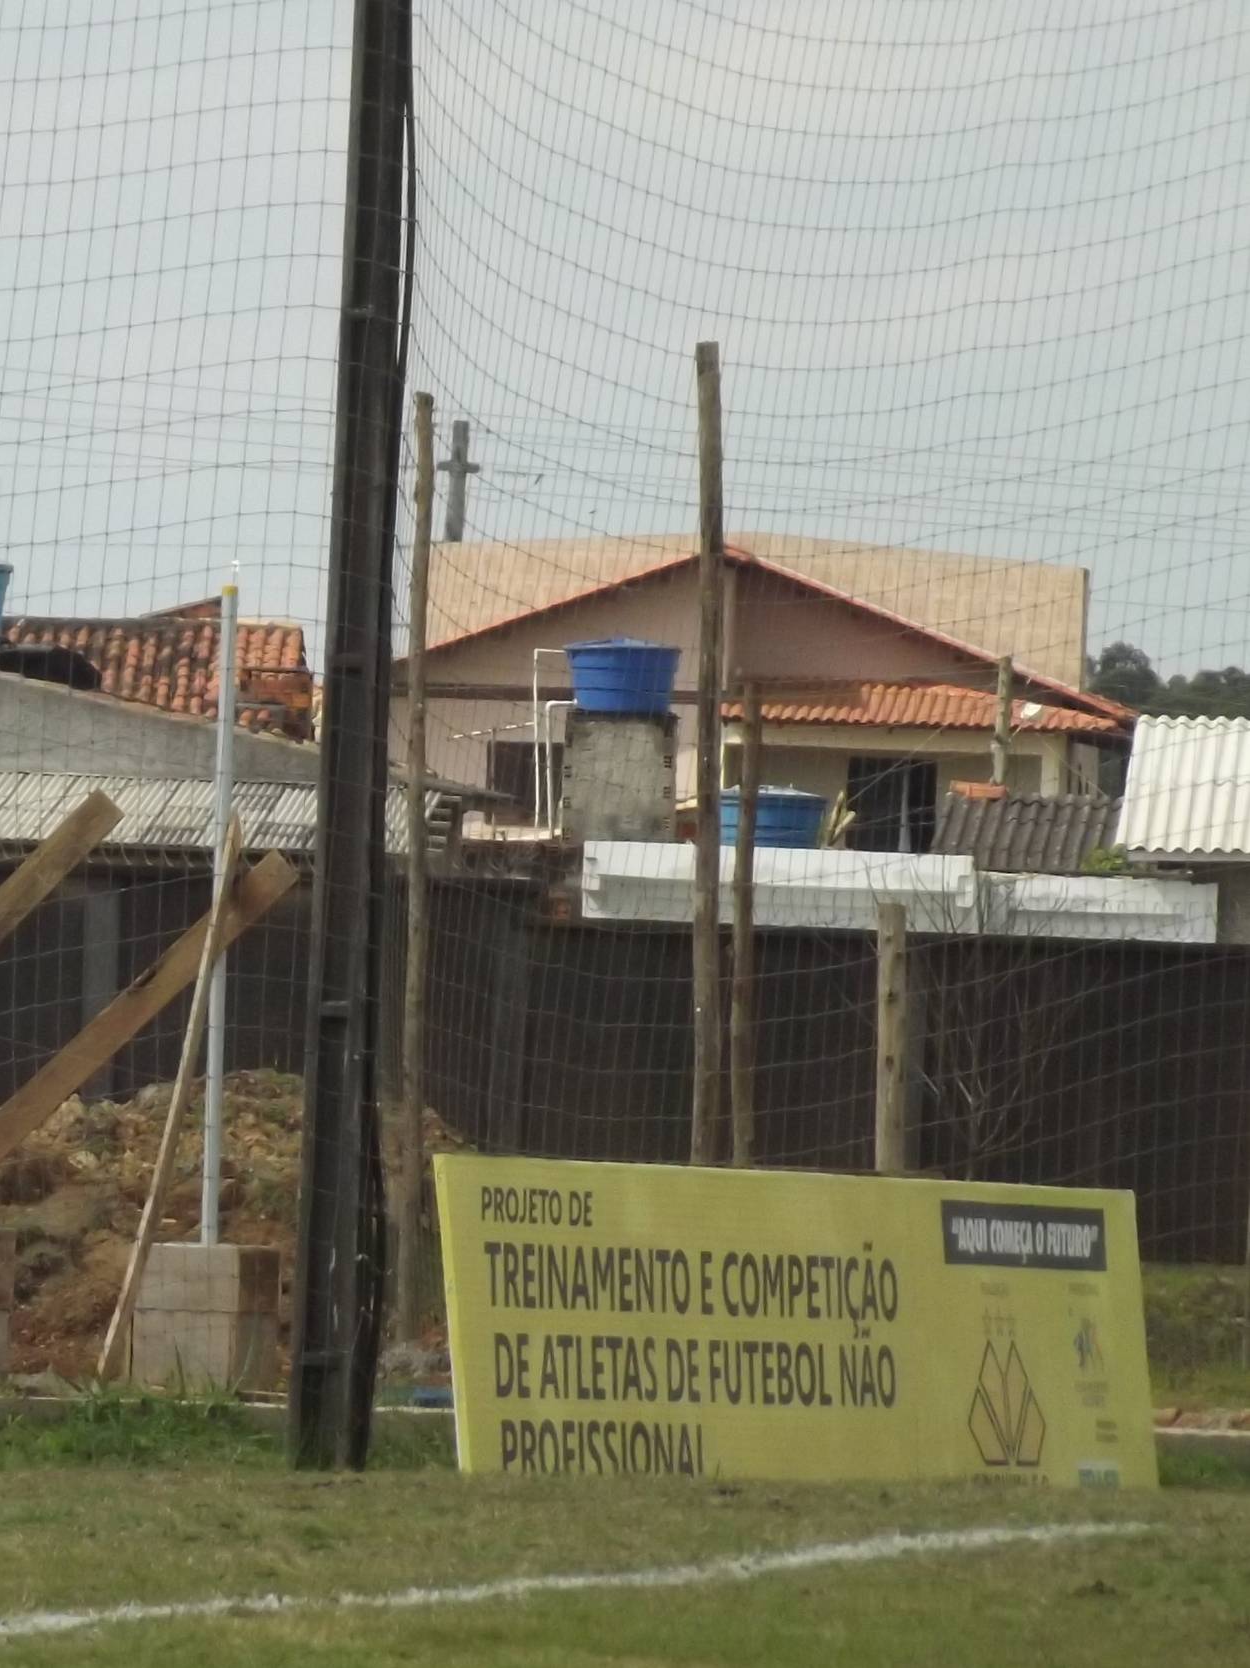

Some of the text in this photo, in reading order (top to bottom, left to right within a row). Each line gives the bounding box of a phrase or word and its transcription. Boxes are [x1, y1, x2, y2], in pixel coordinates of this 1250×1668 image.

[481, 1186, 593, 1227] PROJETO DE
[990, 1219, 1033, 1264] COMEÇA
[1036, 1221, 1045, 1255] O
[484, 1241, 898, 1339] TREINAMENTO E COMPETIÇÃO
[494, 1327, 896, 1409] DE ATLETAS DE FUTEBOL NÃO
